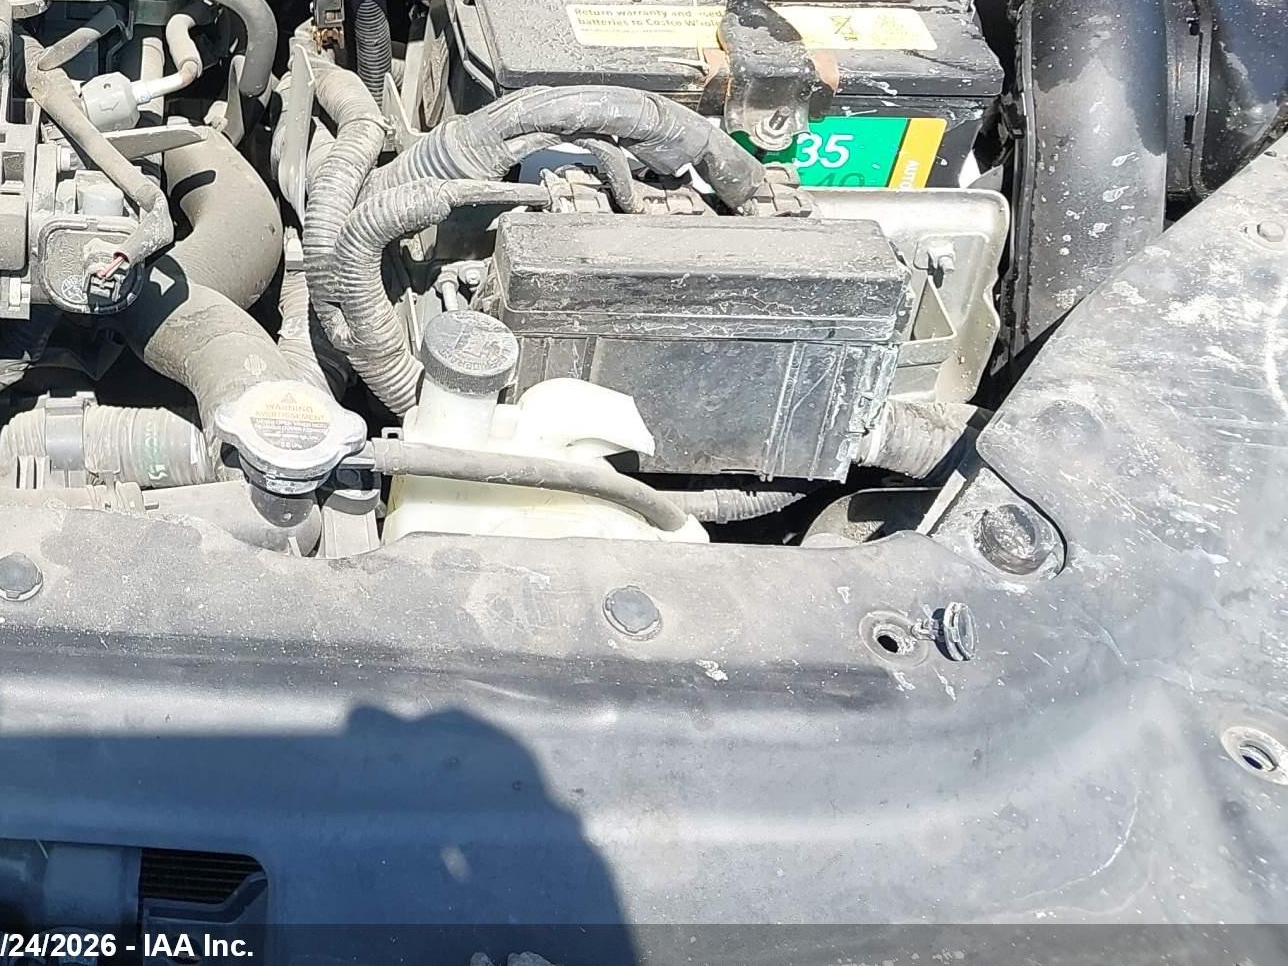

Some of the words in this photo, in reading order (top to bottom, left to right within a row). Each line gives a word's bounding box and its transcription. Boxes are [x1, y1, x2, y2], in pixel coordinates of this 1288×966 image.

[574, 8, 613, 16] Return
[617, 9, 668, 18] warranty
[671, 9, 692, 17] and
[578, 17, 629, 26] batteries
[632, 18, 644, 26] to
[646, 18, 683, 27] Costco
[793, 133, 855, 168] 35
[265, 402, 313, 413] WARNING
[255, 411, 325, 421] AVERTISSEMENT
